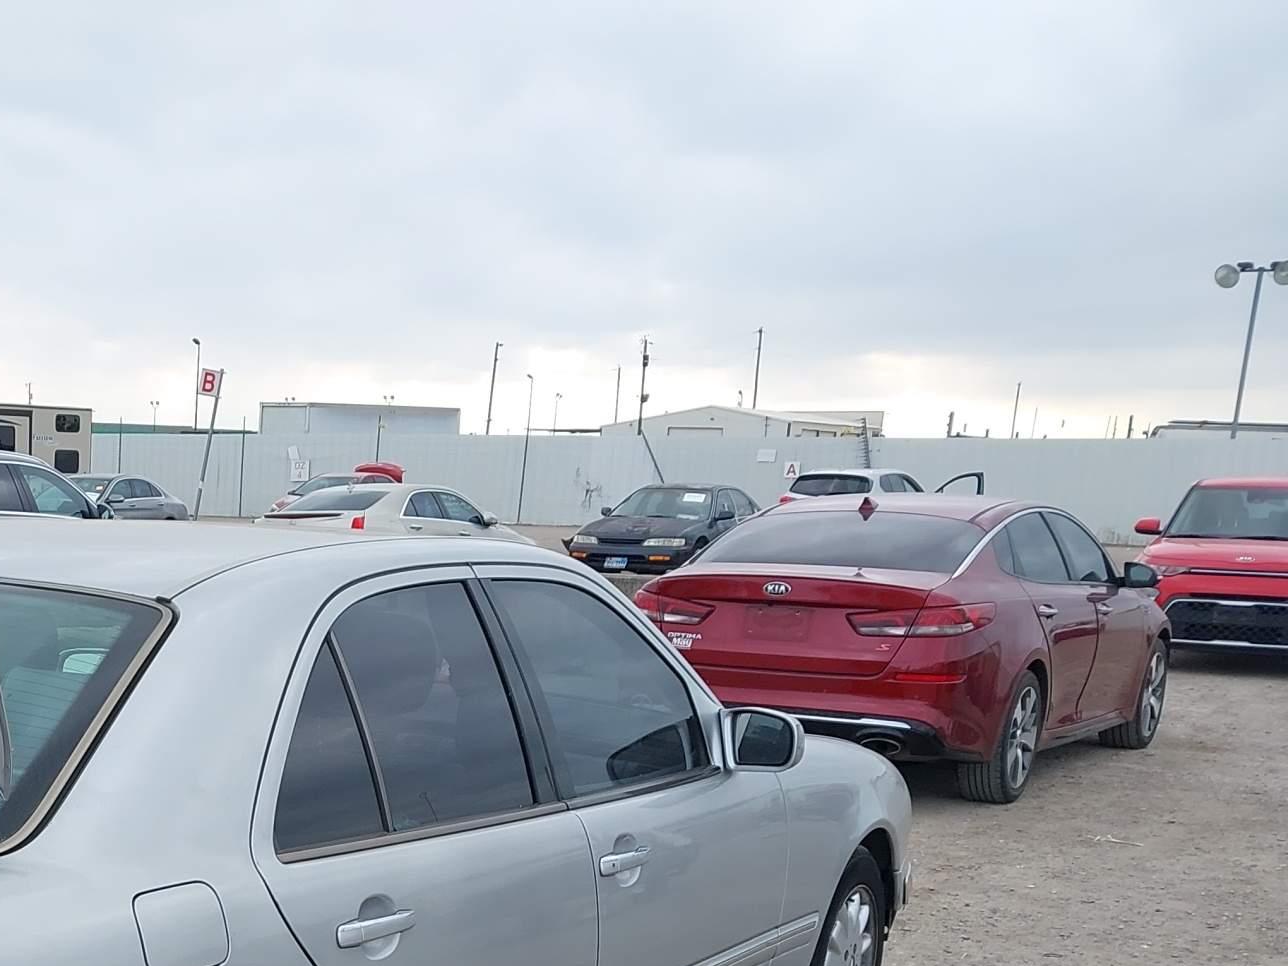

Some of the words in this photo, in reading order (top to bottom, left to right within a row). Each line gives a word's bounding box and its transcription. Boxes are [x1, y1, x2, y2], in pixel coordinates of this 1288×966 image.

[202, 371, 216, 392] B
[785, 463, 797, 476] A
[767, 584, 786, 594] KIA
[667, 631, 703, 640] OPTIMA
